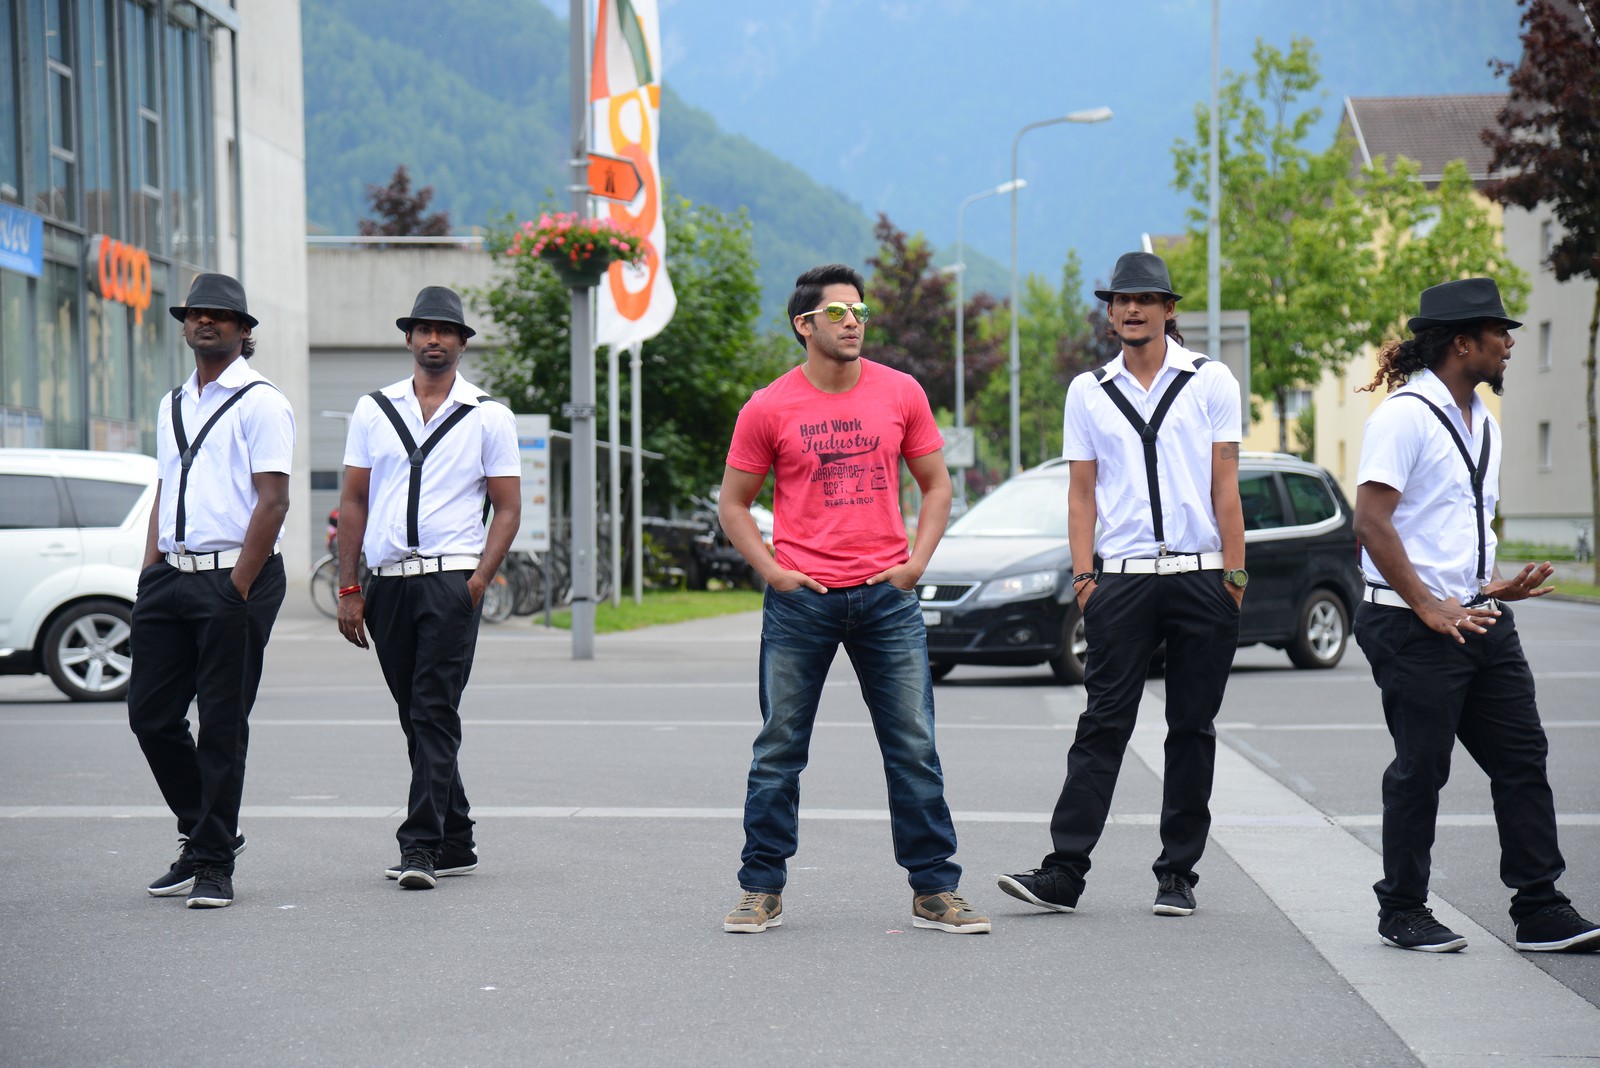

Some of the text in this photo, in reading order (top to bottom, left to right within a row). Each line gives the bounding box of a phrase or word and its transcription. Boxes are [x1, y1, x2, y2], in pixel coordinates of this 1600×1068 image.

[98, 233, 152, 326] coop
[800, 418, 862, 437] Hard Work
[801, 434, 880, 453] Industry
[824, 499, 848, 507] STEEL
[857, 497, 874, 505] IRON
